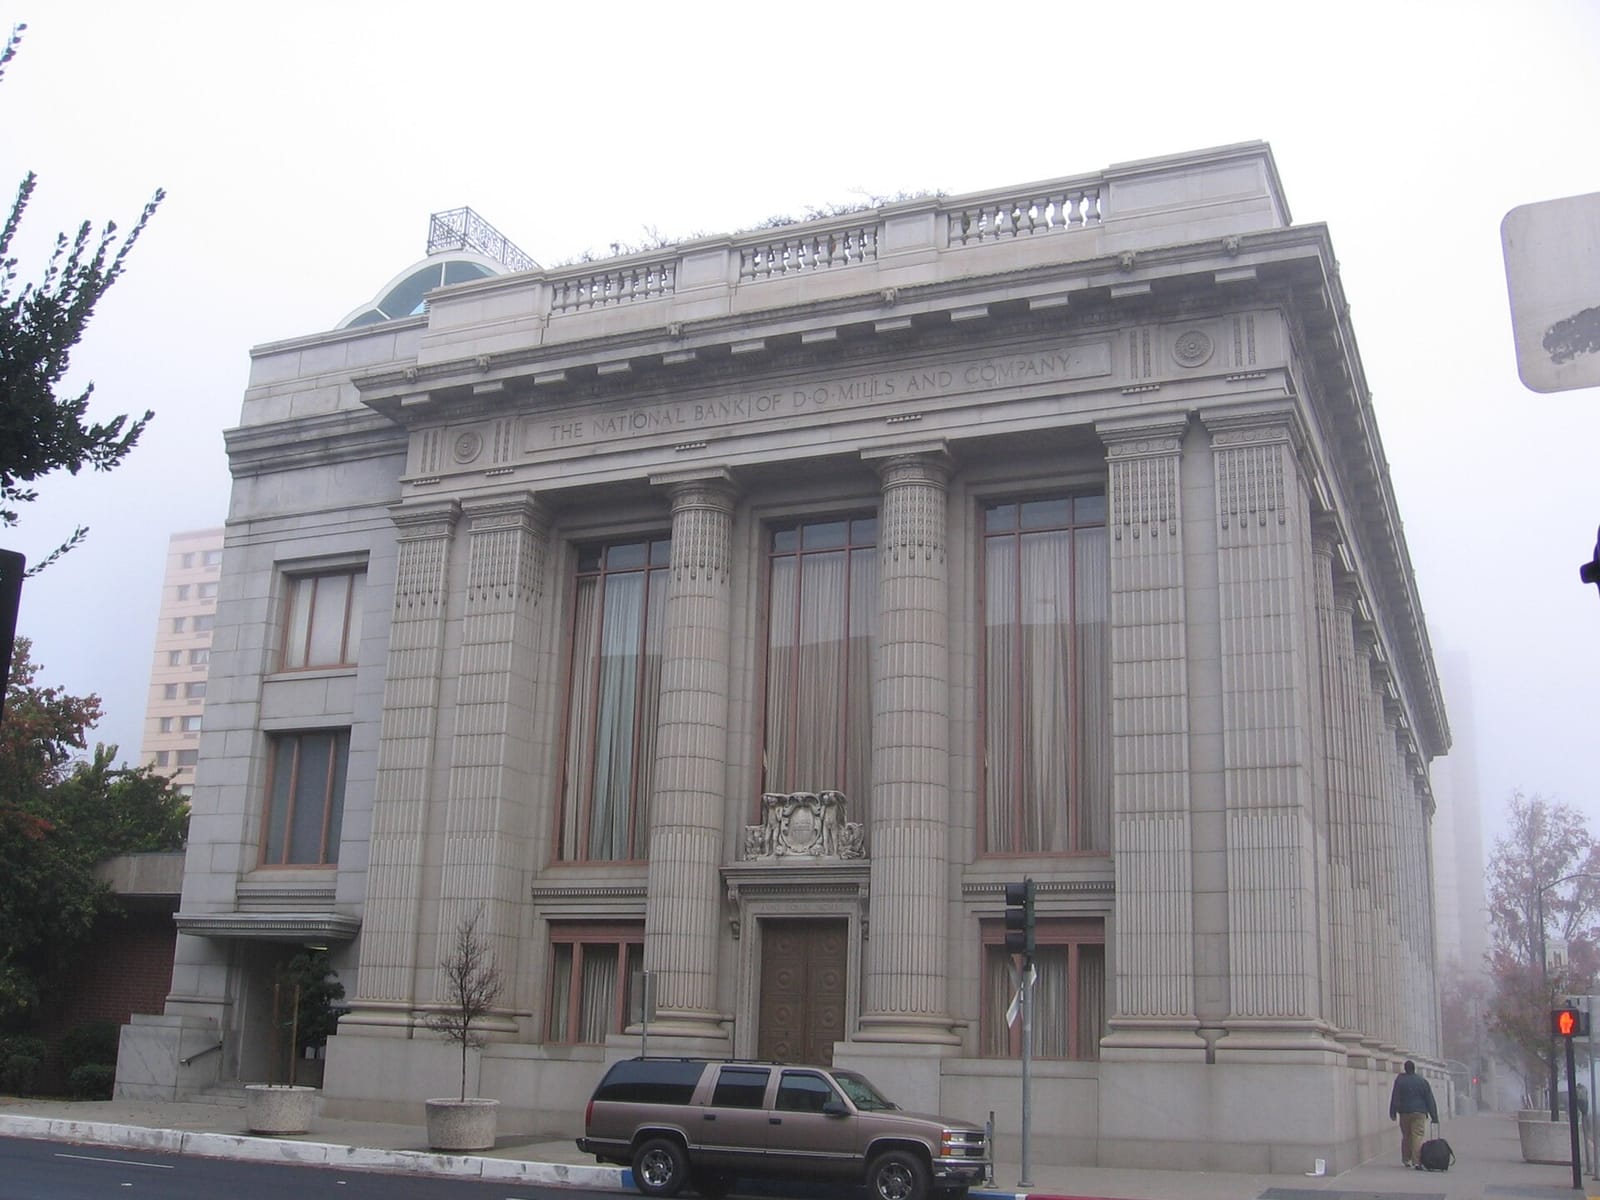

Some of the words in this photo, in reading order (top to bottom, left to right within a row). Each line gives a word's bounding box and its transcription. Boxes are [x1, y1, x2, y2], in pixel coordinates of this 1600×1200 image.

[551, 422, 583, 442] THE
[592, 407, 686, 437] NATIONAL
[694, 401, 749, 422] BANK
[755, 394, 782, 413] OF
[906, 371, 953, 393] AND
